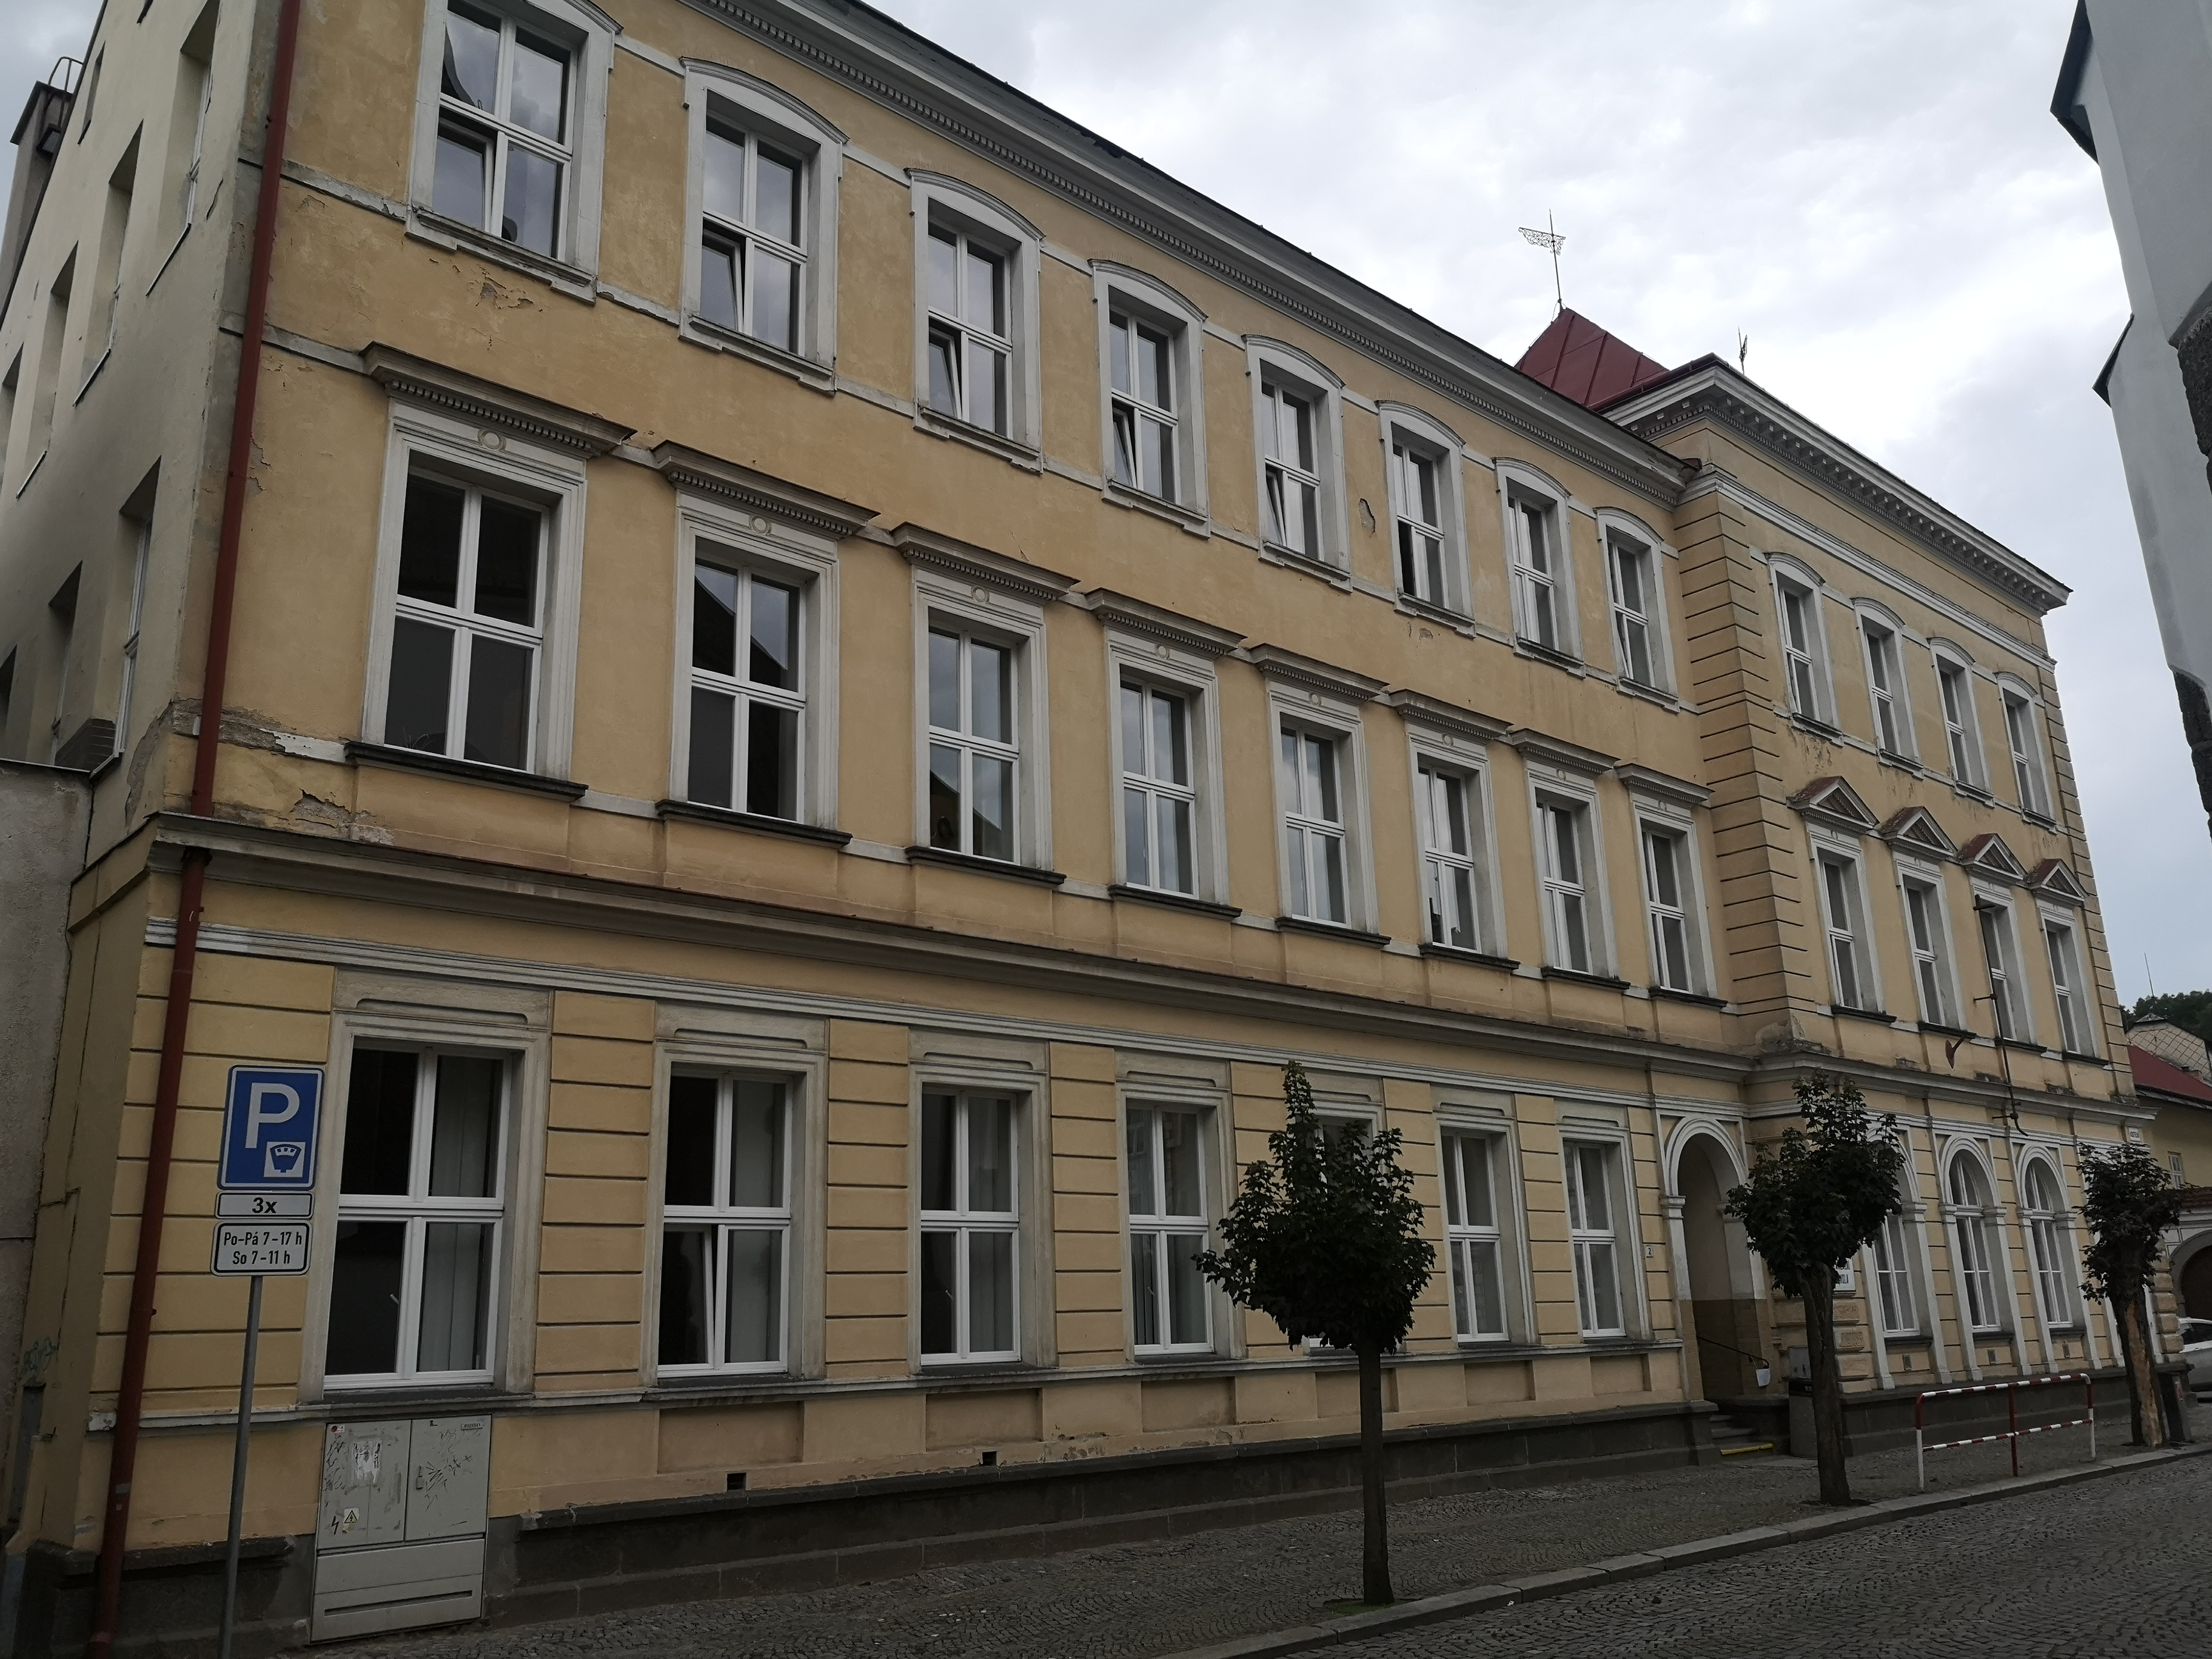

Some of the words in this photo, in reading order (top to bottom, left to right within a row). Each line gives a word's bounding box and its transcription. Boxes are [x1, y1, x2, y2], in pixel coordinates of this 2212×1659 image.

[245, 1082, 300, 1148] P
[252, 1197, 278, 1213] 3x
[224, 1232, 258, 1245] Po-Pá
[295, 1232, 302, 1245] h
[232, 1250, 247, 1264] So
[284, 1250, 290, 1264] h
